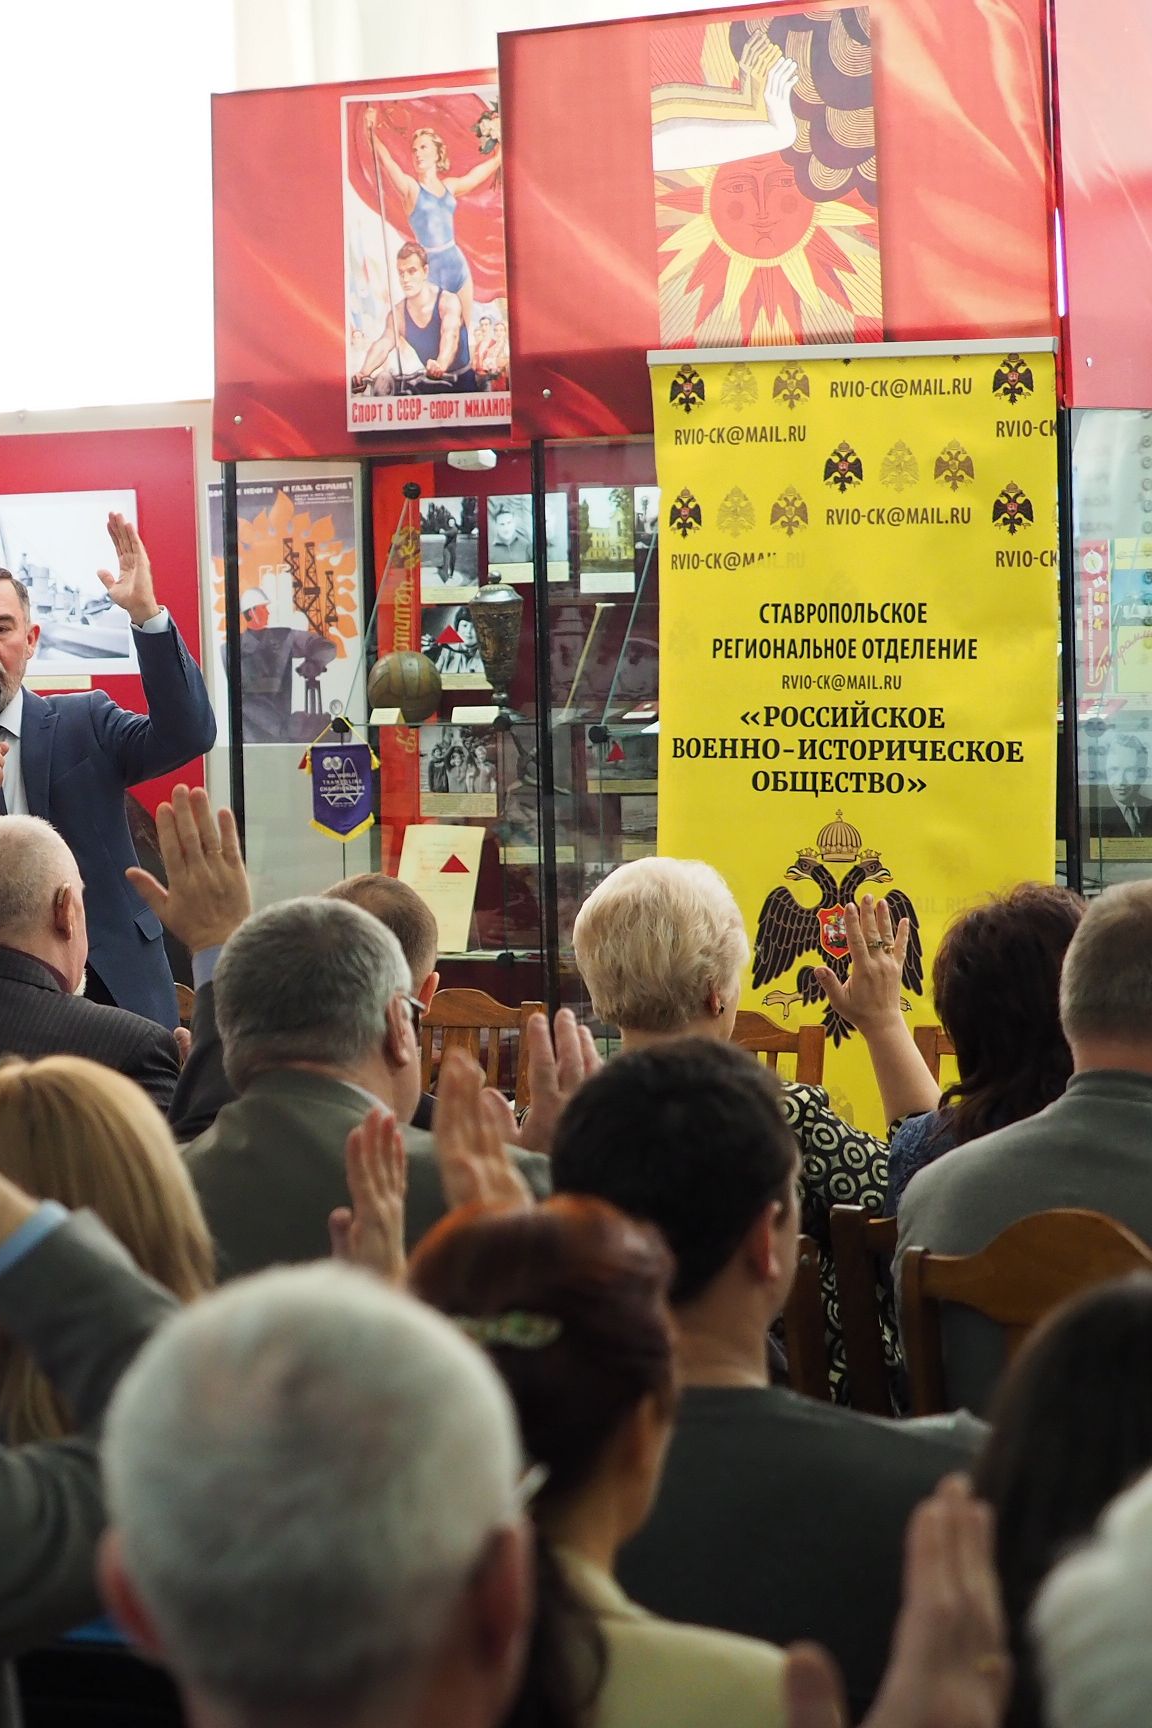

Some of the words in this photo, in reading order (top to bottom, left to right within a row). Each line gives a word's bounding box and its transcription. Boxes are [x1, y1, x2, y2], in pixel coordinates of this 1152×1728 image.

[830, 378, 972, 398] RVIO-CK@MAIL.RU
[352, 403, 383, 423] СПОРТ
[675, 425, 806, 445] RVIO-CK@MAIL.RU
[291, 484, 313, 492] ГАЗА
[827, 507, 971, 526] RVIO-CK@MAIL.RU
[759, 603, 927, 623] СТАВРОПОЛЬСКОЕ
[712, 638, 857, 659] РЕГИОНАЛЬНОЕ
[861, 638, 978, 663] ОТДЕЛЕНИЕ
[782, 674, 901, 691] RVIO-CK@MAIL.RU
[740, 700, 945, 728] «РОССИЙСКОЕ
[672, 738, 1024, 762] ВОЕННО-ИСТОРИЧЕСКОЕ
[752, 771, 927, 797] ОБЩЕСТВО»
